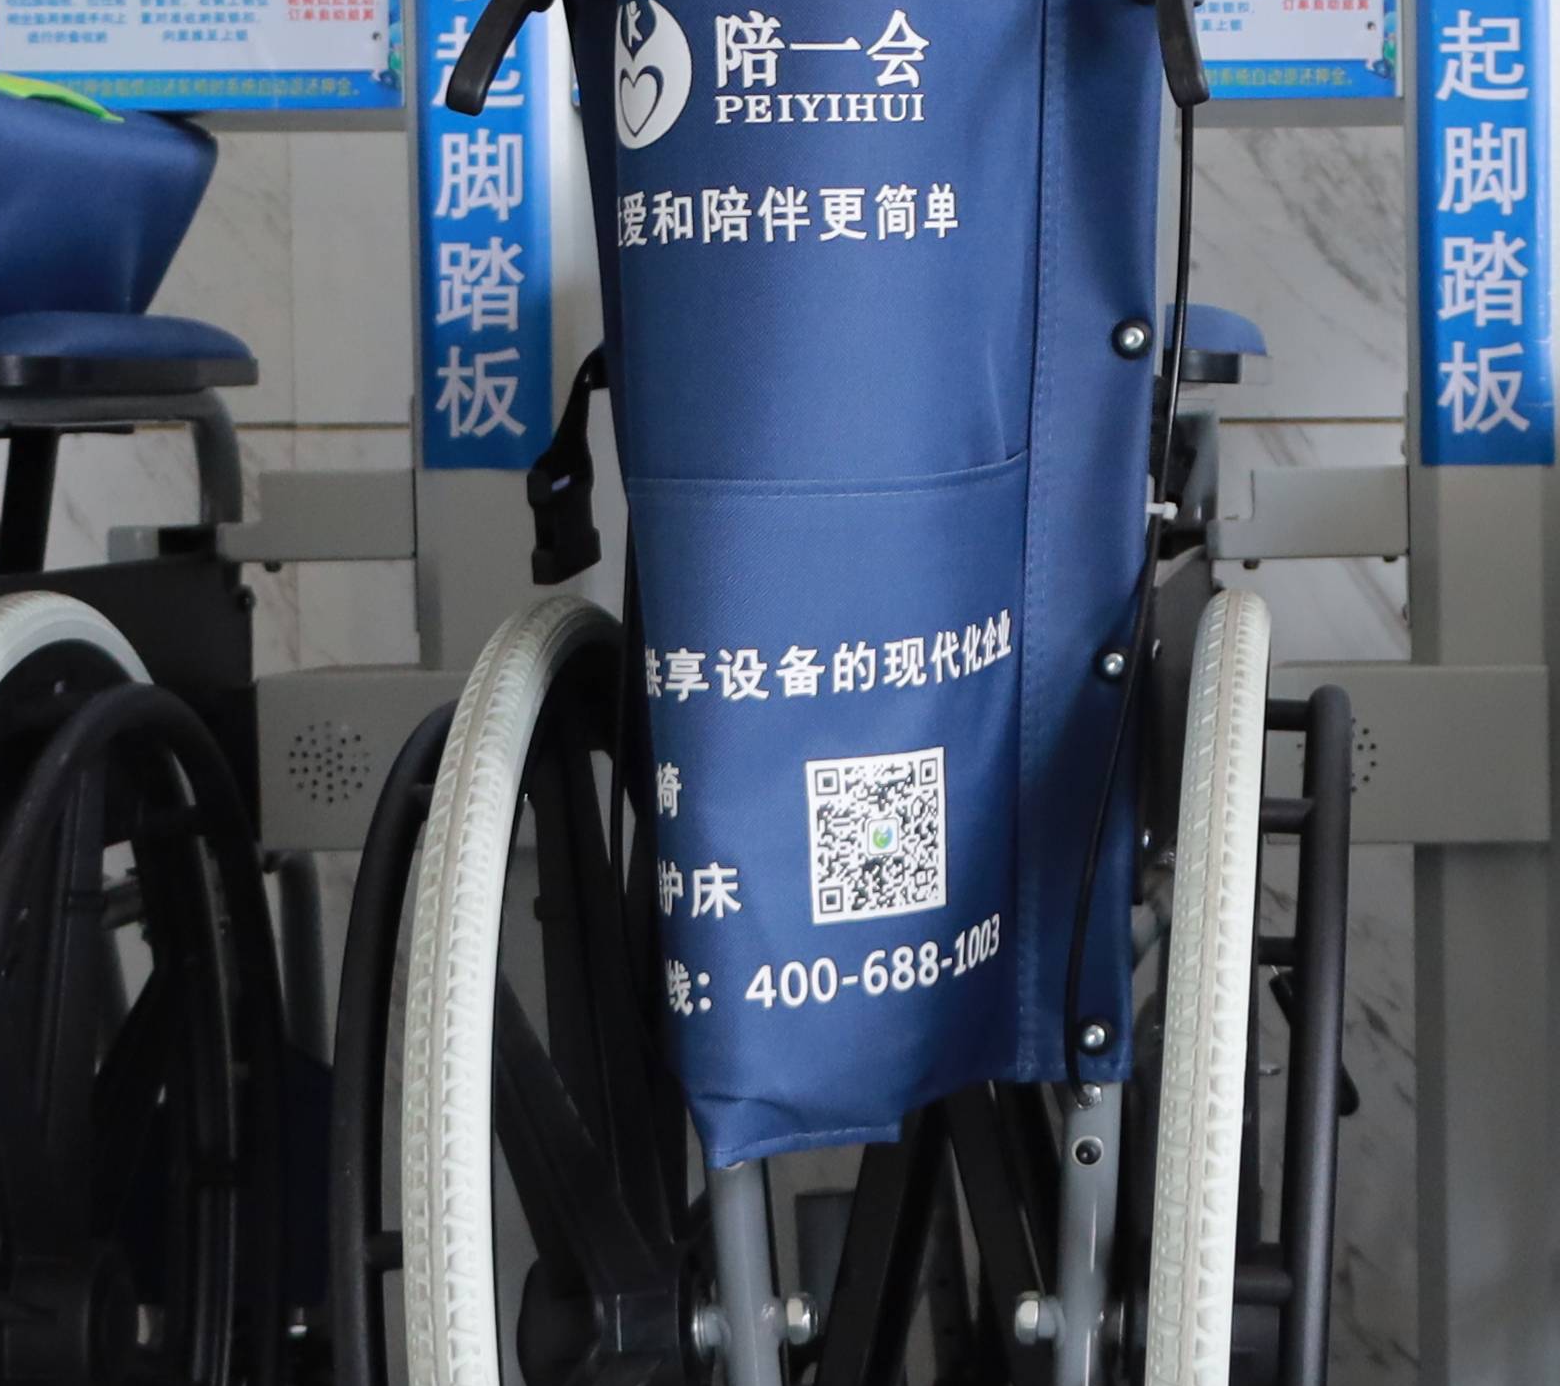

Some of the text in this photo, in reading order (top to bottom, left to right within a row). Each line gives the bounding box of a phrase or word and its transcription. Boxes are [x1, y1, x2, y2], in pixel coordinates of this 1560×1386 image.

[715, 9, 930, 88] 陪一会
[715, 93, 925, 125] PEIYIHUI
[745, 912, 1001, 1009] 400-688-1003
